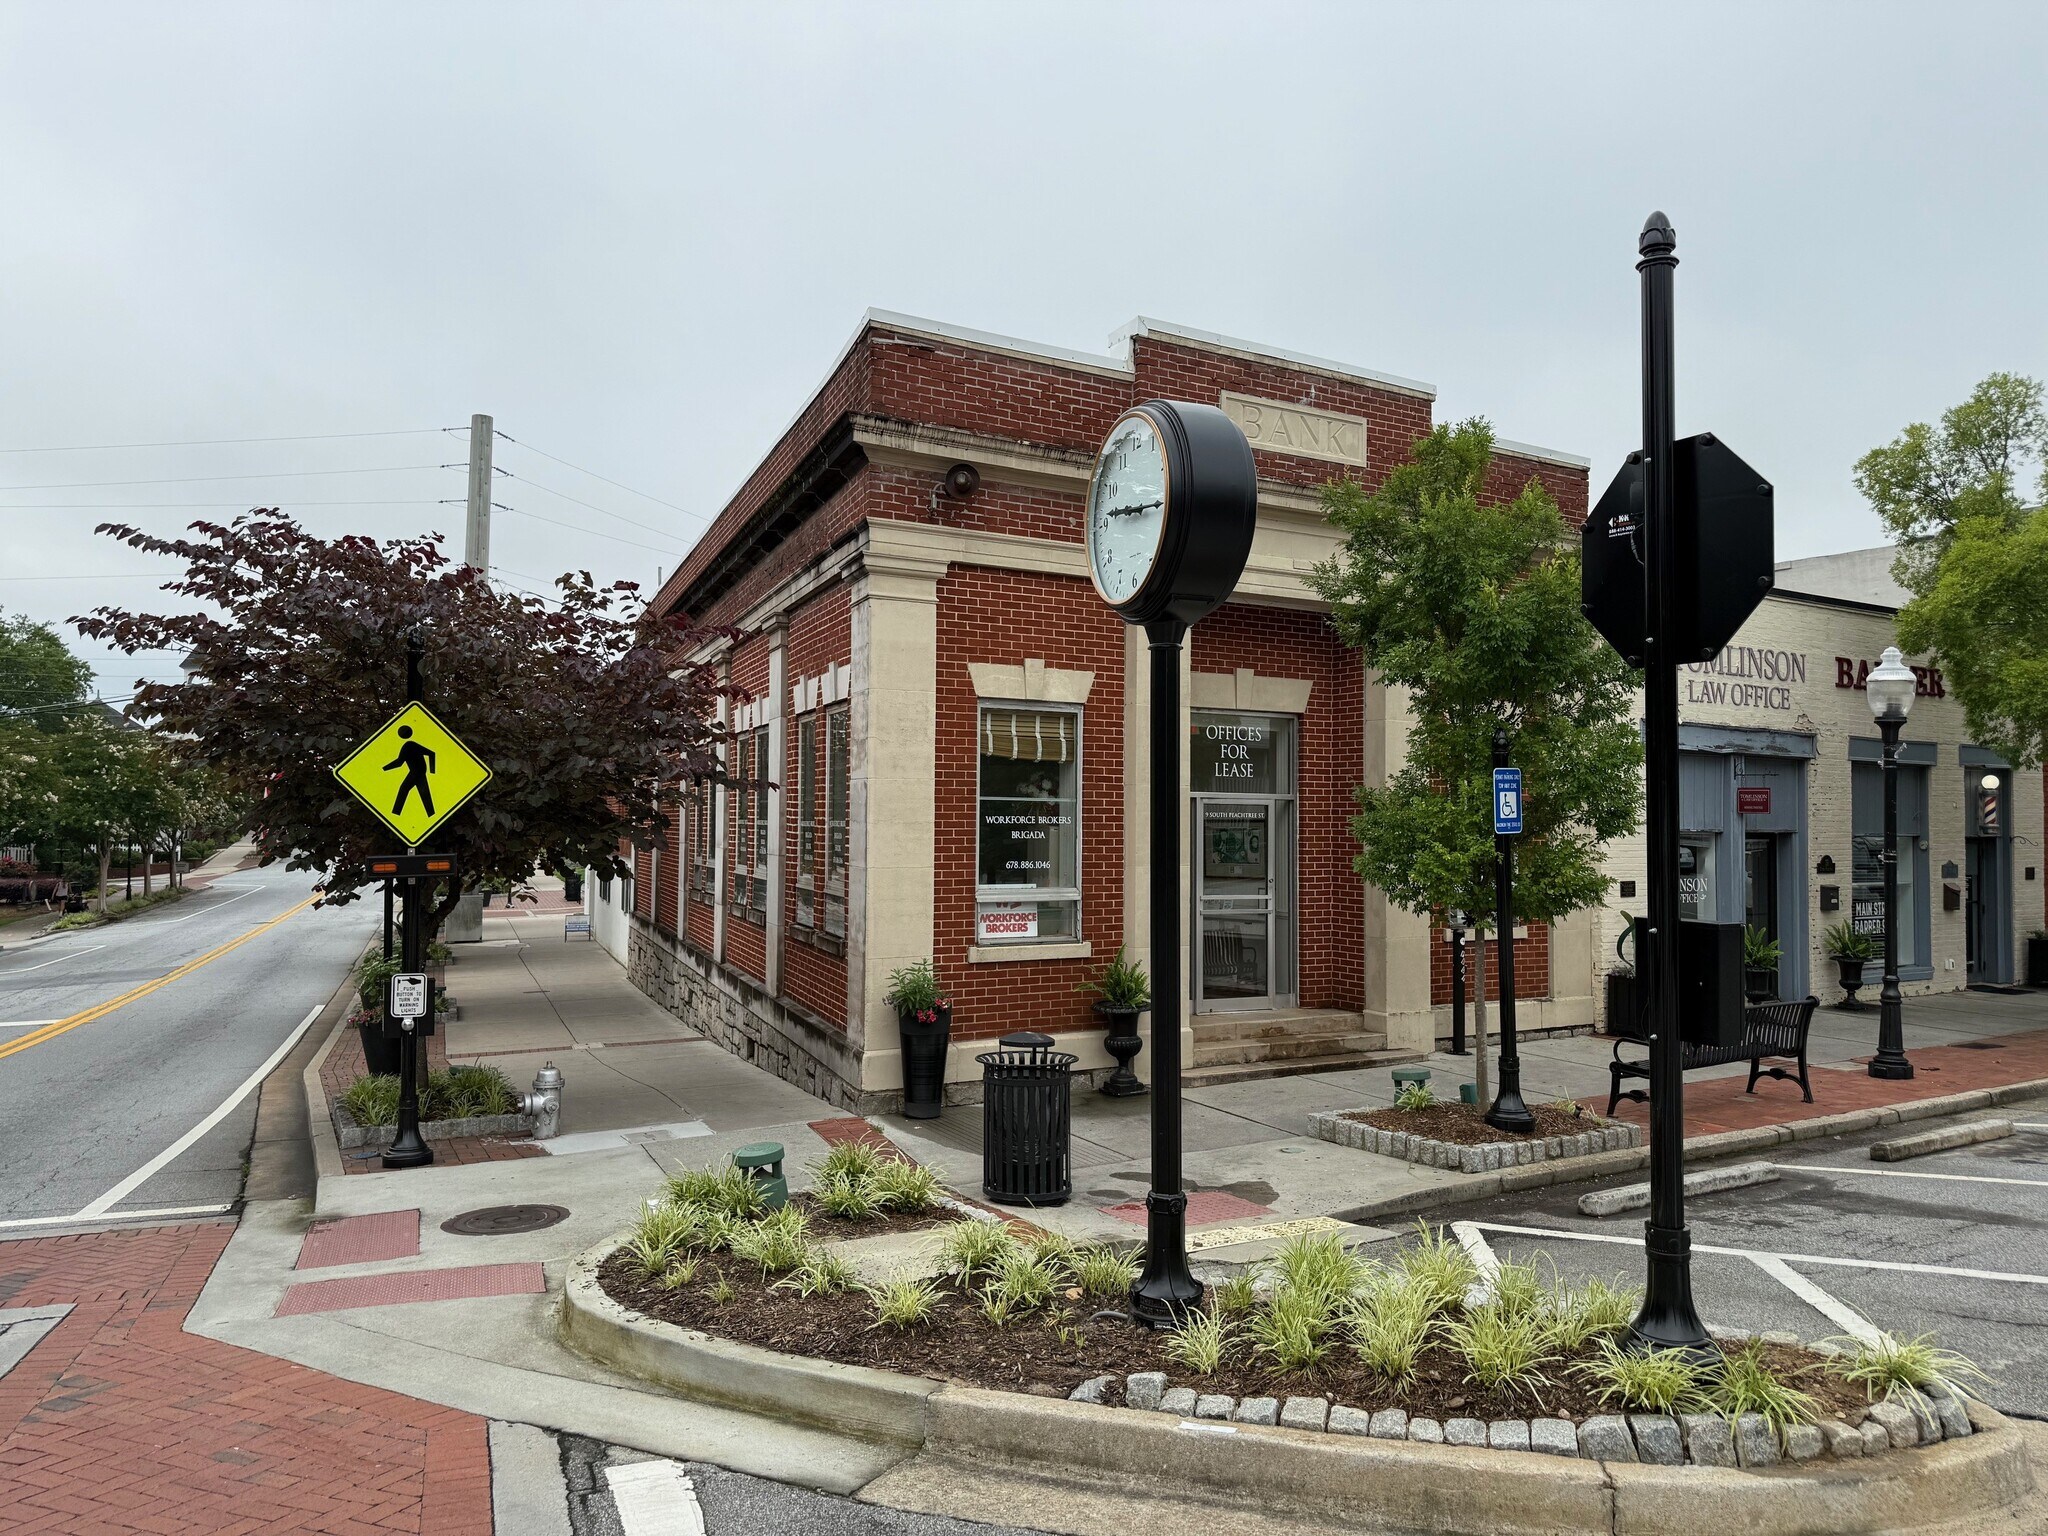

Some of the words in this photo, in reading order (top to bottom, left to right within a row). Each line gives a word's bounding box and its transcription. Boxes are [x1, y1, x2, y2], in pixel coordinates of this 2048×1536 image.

[1241, 404, 1345, 455] BANK
[1132, 433, 1142, 451] 12
[1118, 453, 1127, 471] 11
[1108, 481, 1118, 500] 10
[1103, 517, 1108, 532] 9
[1107, 548, 1113, 564] 8
[1117, 569, 1123, 584] 7
[1131, 572, 1138, 588] 6
[1835, 656, 1946, 699] BAER
[1688, 680, 1728, 704] LAW
[1731, 684, 1791, 710] OFFICE
[1206, 725, 1262, 741] OFFICES
[1220, 743, 1250, 759] FOR
[1215, 762, 1254, 778] LEASE
[985, 816, 1035, 824] WORKFORCE
[1038, 816, 1071, 824] BROKERS
[1005, 860, 1051, 869] 678.886.1046
[1855, 902, 1873, 916] MAIN
[979, 913, 1037, 923] WORKFORCE
[985, 923, 1029, 933] BROKERS
